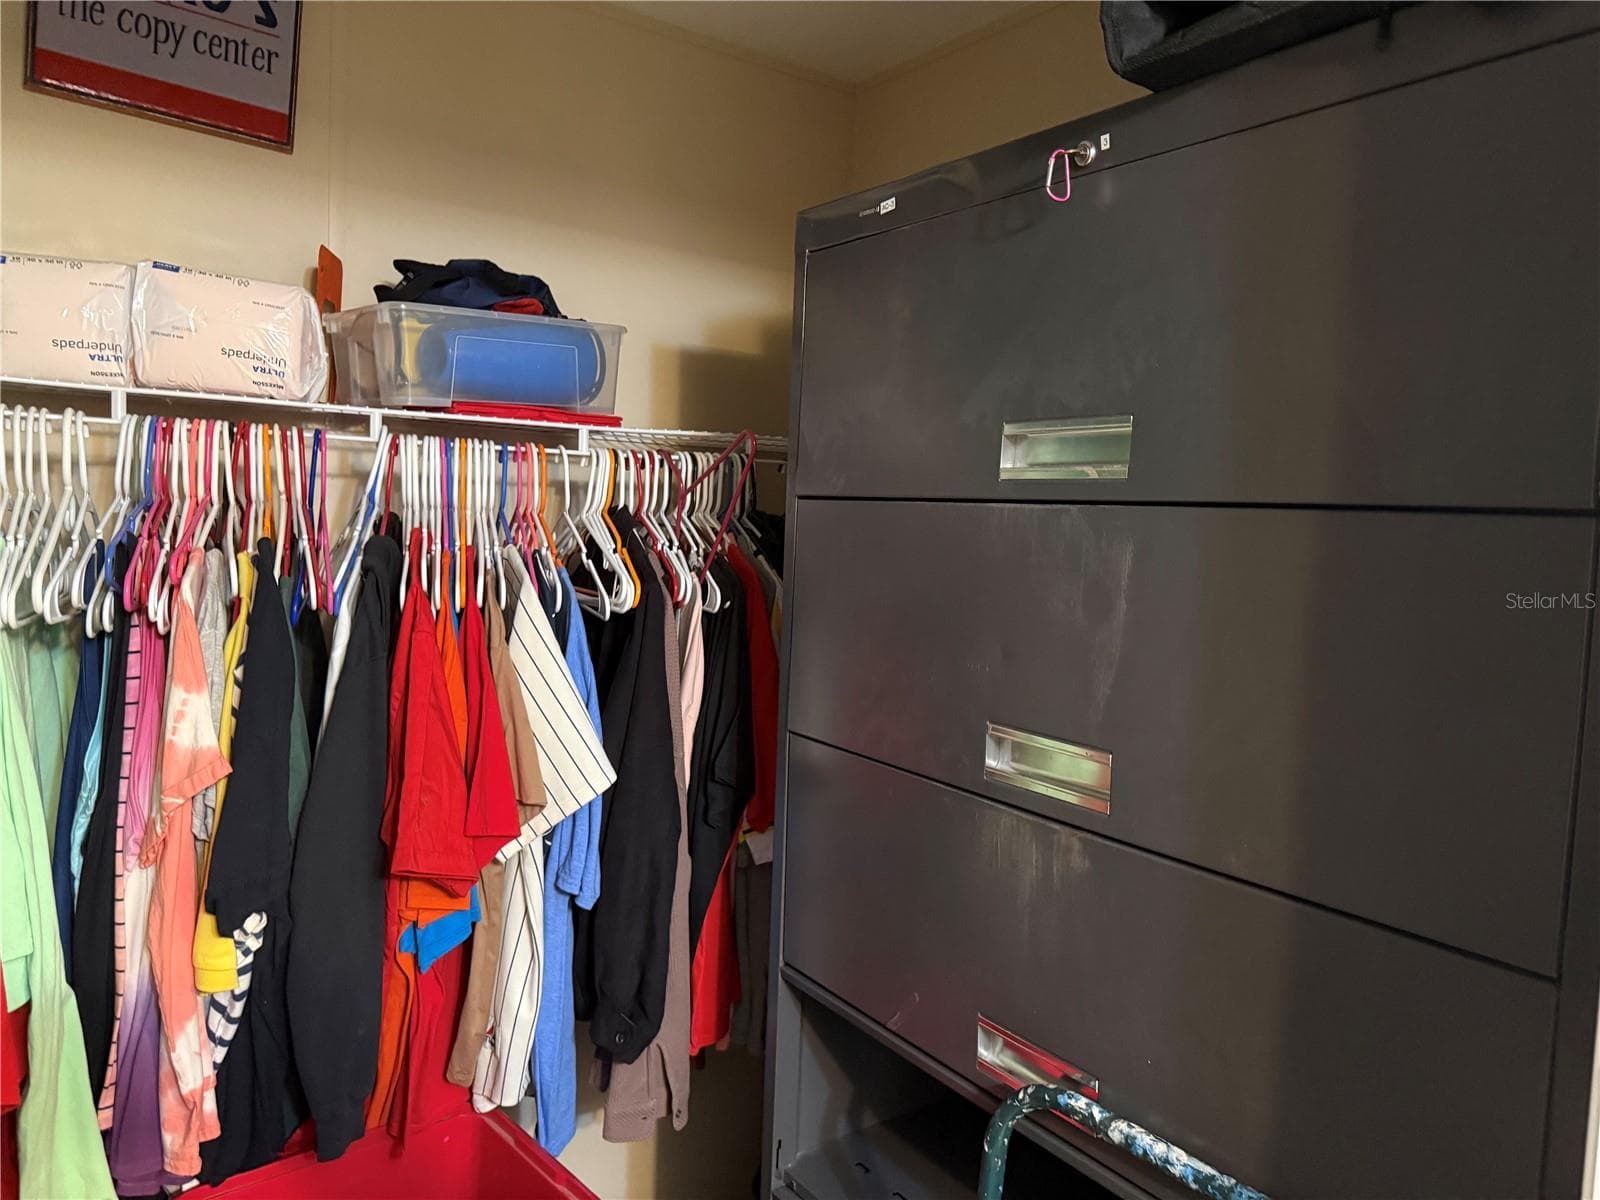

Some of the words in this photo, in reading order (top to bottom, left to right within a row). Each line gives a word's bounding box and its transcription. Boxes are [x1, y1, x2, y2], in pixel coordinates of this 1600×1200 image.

[117, 8, 187, 58] copy
[193, 27, 280, 75] center
[52, 339, 123, 354] Underpads
[88, 354, 123, 363] ULTRA
[252, 365, 285, 379] ULTRA
